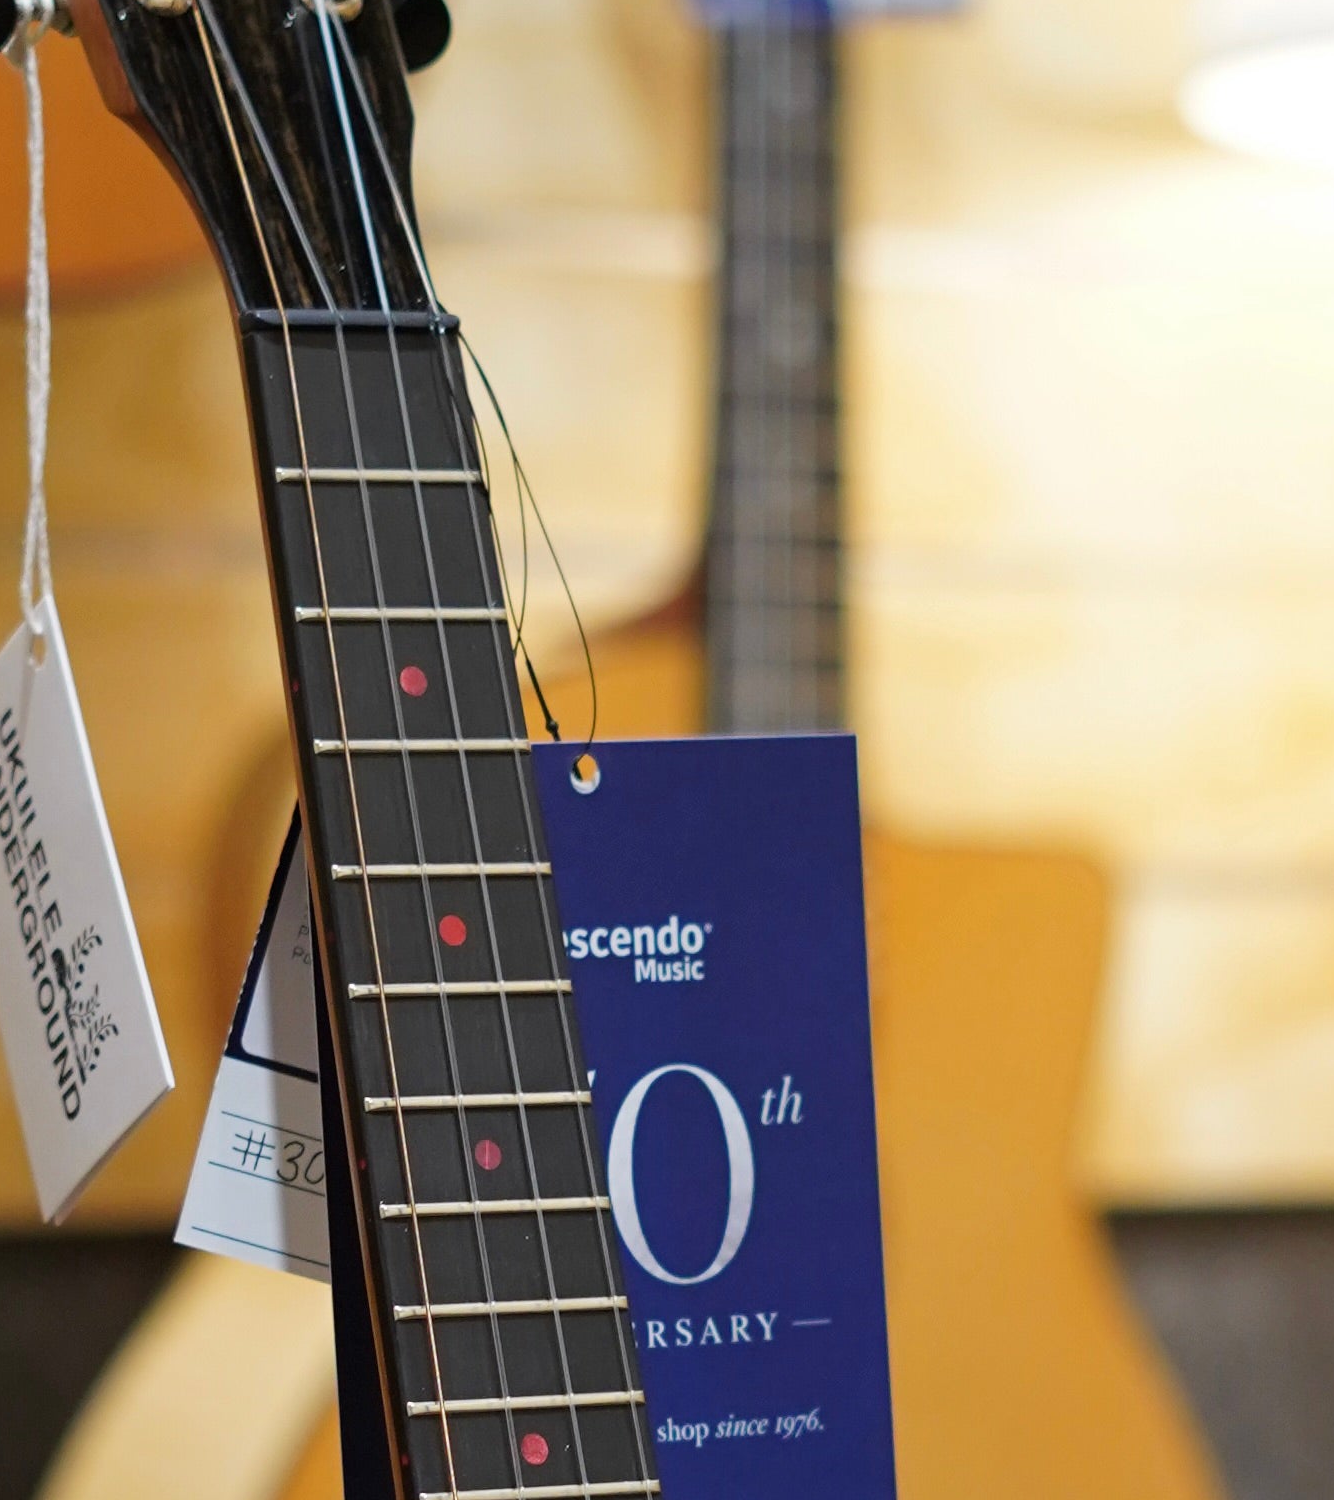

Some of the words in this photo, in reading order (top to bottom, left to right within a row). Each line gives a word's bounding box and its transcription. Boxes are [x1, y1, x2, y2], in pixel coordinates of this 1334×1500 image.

[0, 708, 62, 942] UKULELE
[634, 956, 705, 983] Music
[657, 1417, 710, 1447] shop
[715, 1413, 768, 1439] since
[774, 1407, 824, 1440] 1976.
